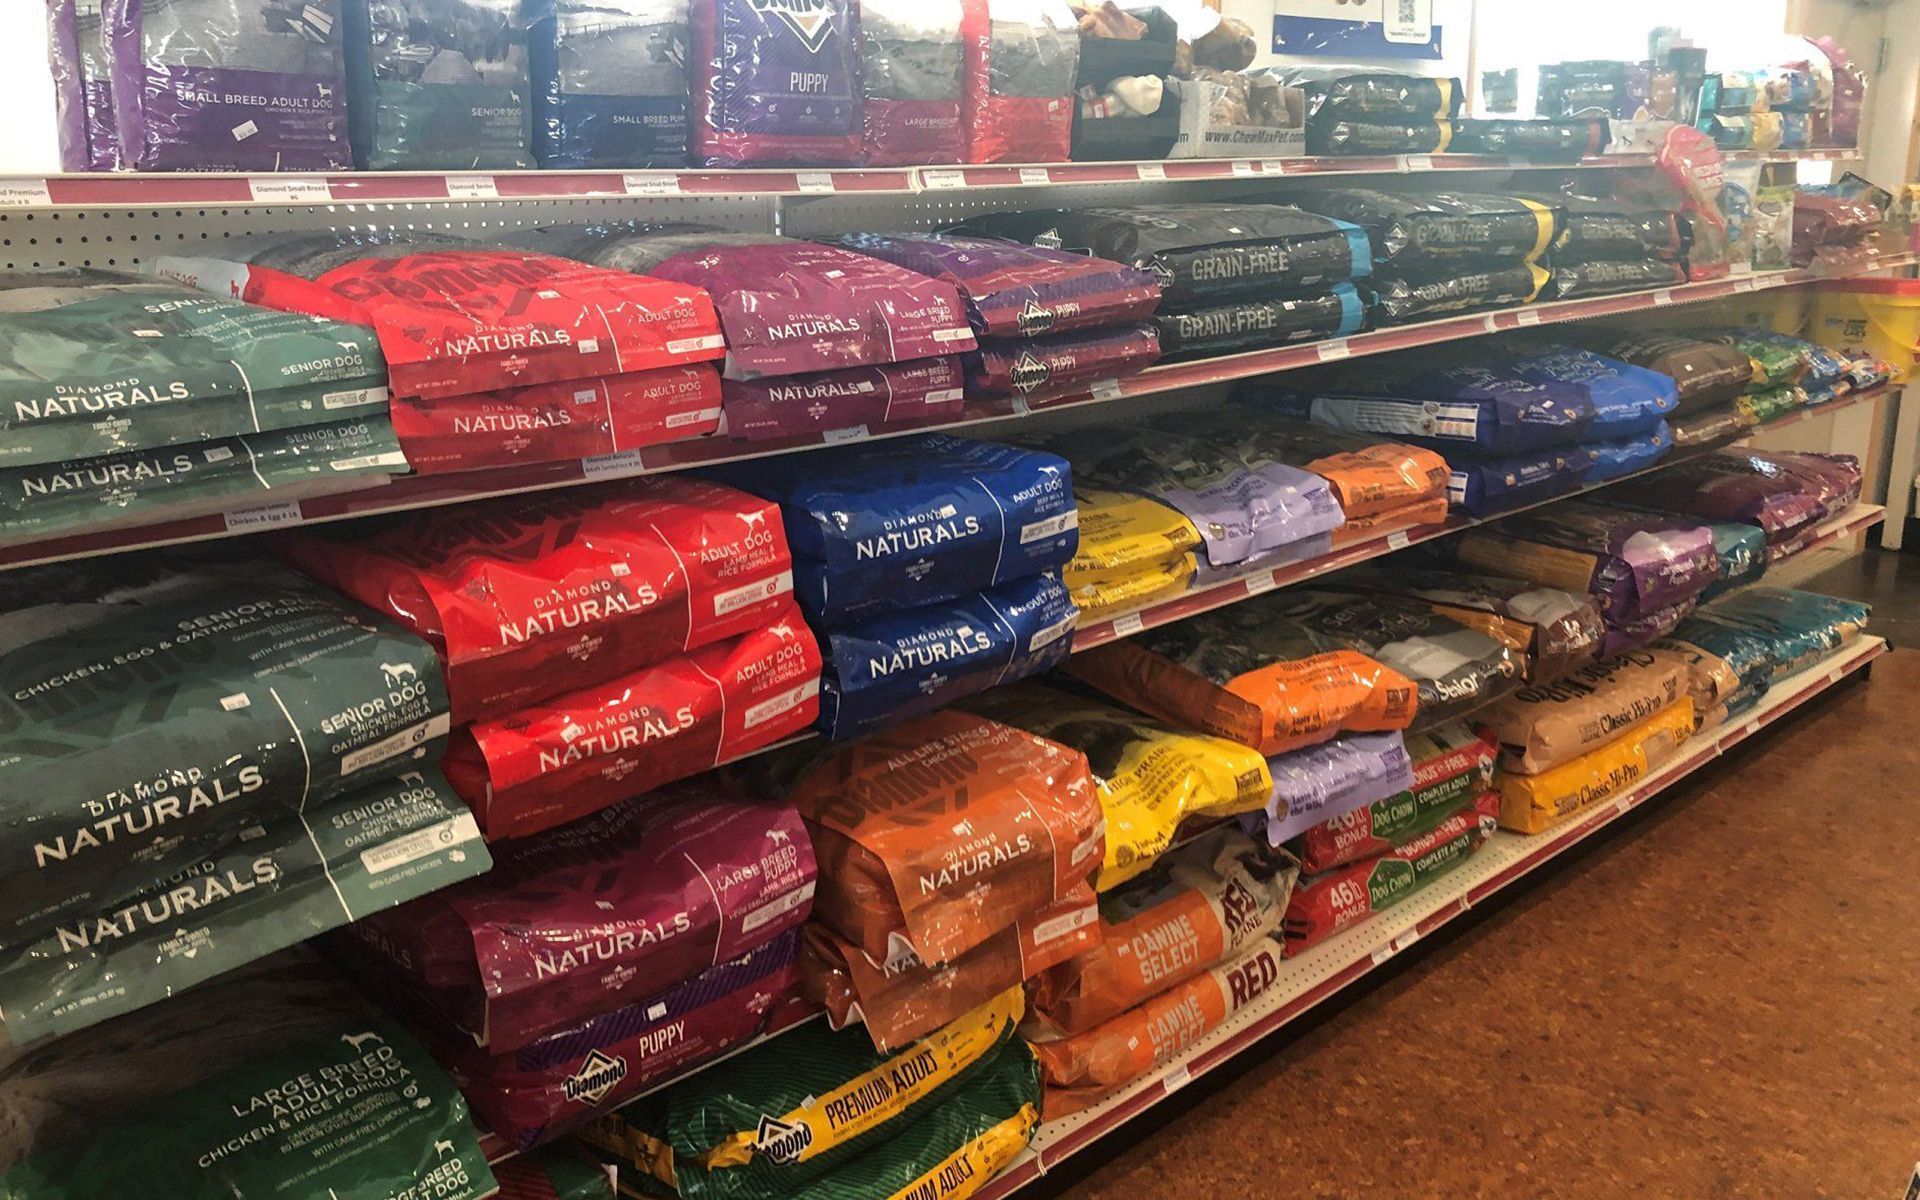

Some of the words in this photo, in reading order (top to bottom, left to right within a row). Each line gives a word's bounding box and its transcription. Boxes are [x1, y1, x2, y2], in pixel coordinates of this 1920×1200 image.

[790, 72, 828, 92] PUPPY
[176, 89, 221, 103] SMALL
[225, 94, 267, 106] BREED
[271, 97, 308, 108] ADULT
[312, 99, 333, 108] DOG
[471, 107, 507, 117] SENIOR
[613, 115, 640, 124] SMALL
[904, 118, 928, 126] LARGE
[1192, 251, 1290, 282] GRAIN-FREE
[1419, 274, 1490, 299] GRAIN-FREE
[638, 311, 670, 324] ADULT
[672, 307, 696, 320] DOG
[900, 309, 926, 318] LARGE
[1056, 303, 1080, 318] PUPPY
[1180, 308, 1278, 338] GRAIN-FREE
[446, 329, 572, 357] NATURALS
[474, 322, 536, 334] DIAMOND
[768, 318, 861, 340] NATURALS
[281, 358, 333, 376] SENIOR
[336, 354, 363, 368] DOG
[56, 378, 140, 394] DIAMOND
[643, 384, 677, 400] ADULT
[678, 380, 701, 394] DOG
[768, 382, 858, 402] NATURALS
[14, 381, 189, 422] NATURALS
[286, 429, 334, 444] SENIOR
[337, 424, 368, 438] DOG
[454, 410, 572, 434] NATURALS
[22, 454, 194, 497] NATURALS
[1013, 484, 1043, 504] ADULT
[1044, 478, 1063, 492] DOG
[883, 510, 941, 530] DIAMOND
[699, 542, 741, 564] ADULT
[744, 530, 773, 552] DOG
[856, 516, 981, 560] NATURALS
[717, 564, 738, 578] RICE
[740, 553, 778, 574] FORMULA
[723, 556, 746, 570] LAMB
[533, 580, 611, 608] DIAMOND
[176, 611, 262, 644] OATMEAL
[178, 599, 273, 631] SENIOR
[499, 583, 658, 648] NATURALS
[896, 627, 954, 648] DIAMOND
[736, 655, 774, 684] ADULT
[776, 642, 803, 664] DOG
[870, 631, 991, 678] NATURALS
[14, 662, 111, 701] CHICKEN,
[114, 647, 154, 666] EGG
[160, 641, 173, 650] &
[770, 664, 808, 686] FORMULA
[1434, 672, 1478, 701] Senior
[321, 698, 387, 734] SENIOR
[390, 680, 426, 706] DOG
[577, 706, 650, 735] DIAMOND
[1600, 706, 1632, 734] Classic
[1632, 694, 1661, 720] Hi-Pro
[332, 728, 381, 754] OATMEAL
[384, 706, 432, 733] FORMULA
[540, 704, 692, 774] NATURALS
[888, 754, 912, 772] ALL
[912, 741, 942, 760] LIFE
[1413, 764, 1438, 784] ONUS
[1444, 754, 1468, 772] FREE
[1418, 782, 1450, 804] COMPLETE
[1451, 774, 1470, 790] ADULT
[1580, 780, 1610, 804] Classic
[1610, 763, 1639, 788] Hi-Pro
[34, 766, 264, 868] NATURALS
[332, 798, 398, 830] SENIOR
[400, 786, 436, 804] DOG
[361, 808, 411, 831] CHICKEN,
[1374, 812, 1391, 828] DOG
[1391, 802, 1414, 820] CHOW
[344, 824, 396, 848] OATMEAL
[398, 808, 449, 828] FORMULA
[1334, 825, 1368, 850] BONUS
[943, 832, 998, 862] DIAMOND
[1416, 848, 1448, 872] COMPLETE
[1450, 834, 1470, 852] ADULT
[416, 860, 442, 874] CHICKEN
[716, 866, 760, 892] LARGE
[761, 845, 796, 866] BREED
[764, 857, 798, 883] PUPPY
[919, 834, 1028, 894] NATURALS
[1330, 882, 1354, 909] 46
[1372, 886, 1390, 902] DOG
[1390, 873, 1412, 892] CHOW
[56, 857, 277, 954] NATURALS
[1219, 878, 1258, 935] RED
[1335, 900, 1366, 926] BONUS
[534, 912, 691, 980] NATURALS
[1132, 913, 1195, 961] CANINE
[1140, 935, 1199, 986] SELECT
[1226, 950, 1278, 1011] RED
[1146, 995, 1202, 1046] CANINE
[638, 1020, 686, 1058] PUPPY
[1154, 1016, 1206, 1060] SELECT
[232, 1072, 314, 1119] LARGE
[318, 1046, 395, 1080] BREED
[271, 1077, 346, 1119] ADULT
[352, 1058, 402, 1084] DOG
[563, 1056, 626, 1100] Diamond
[824, 1075, 894, 1130] PREMIUM
[890, 1050, 940, 1094] ADULT
[198, 1125, 276, 1170] CHICKEN
[278, 1118, 292, 1130] &
[293, 1102, 332, 1124] RICE
[334, 1067, 411, 1102] FORMULA
[436, 1170, 469, 1198] DOG
[938, 1153, 976, 1197] ADULT
